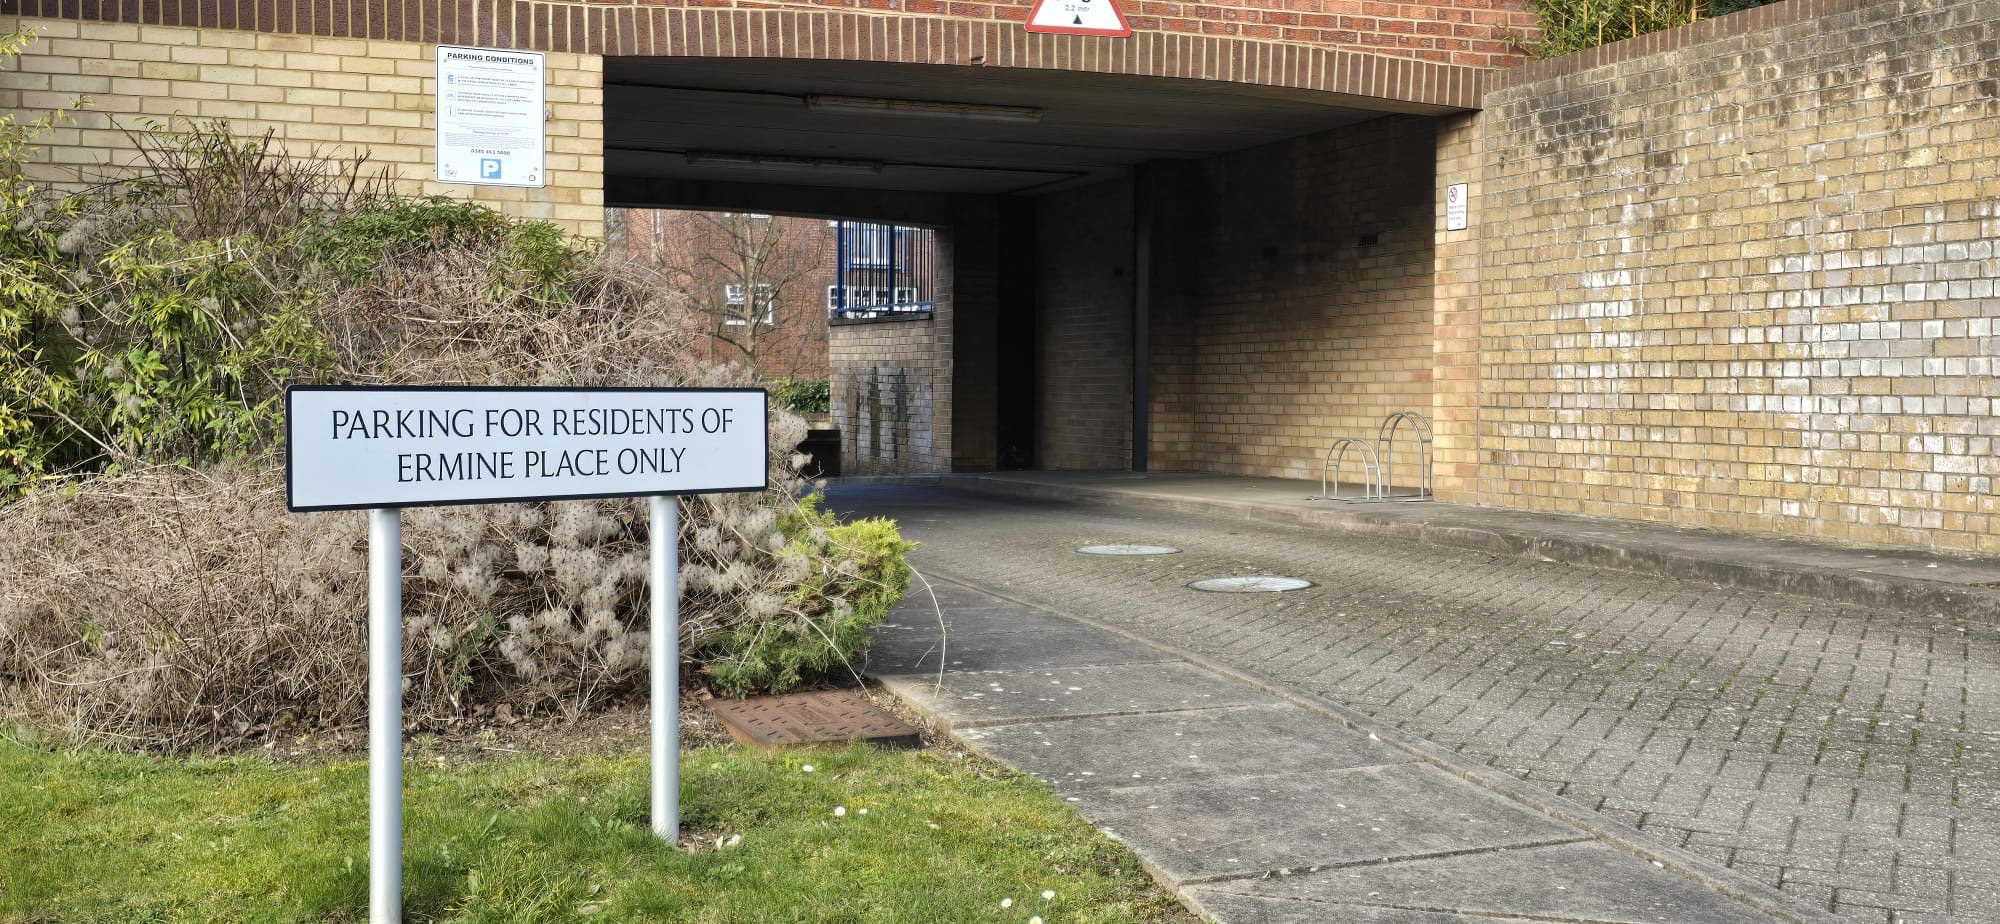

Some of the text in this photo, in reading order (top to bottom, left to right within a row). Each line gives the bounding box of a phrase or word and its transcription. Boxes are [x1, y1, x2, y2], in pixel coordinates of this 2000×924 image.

[447, 52, 534, 65] PARKING CONDITIONS
[483, 161, 499, 177] P
[332, 407, 734, 440] PARKING FOR RESIDENTS OF
[397, 447, 687, 482] ERMINE PLACE ONLY
